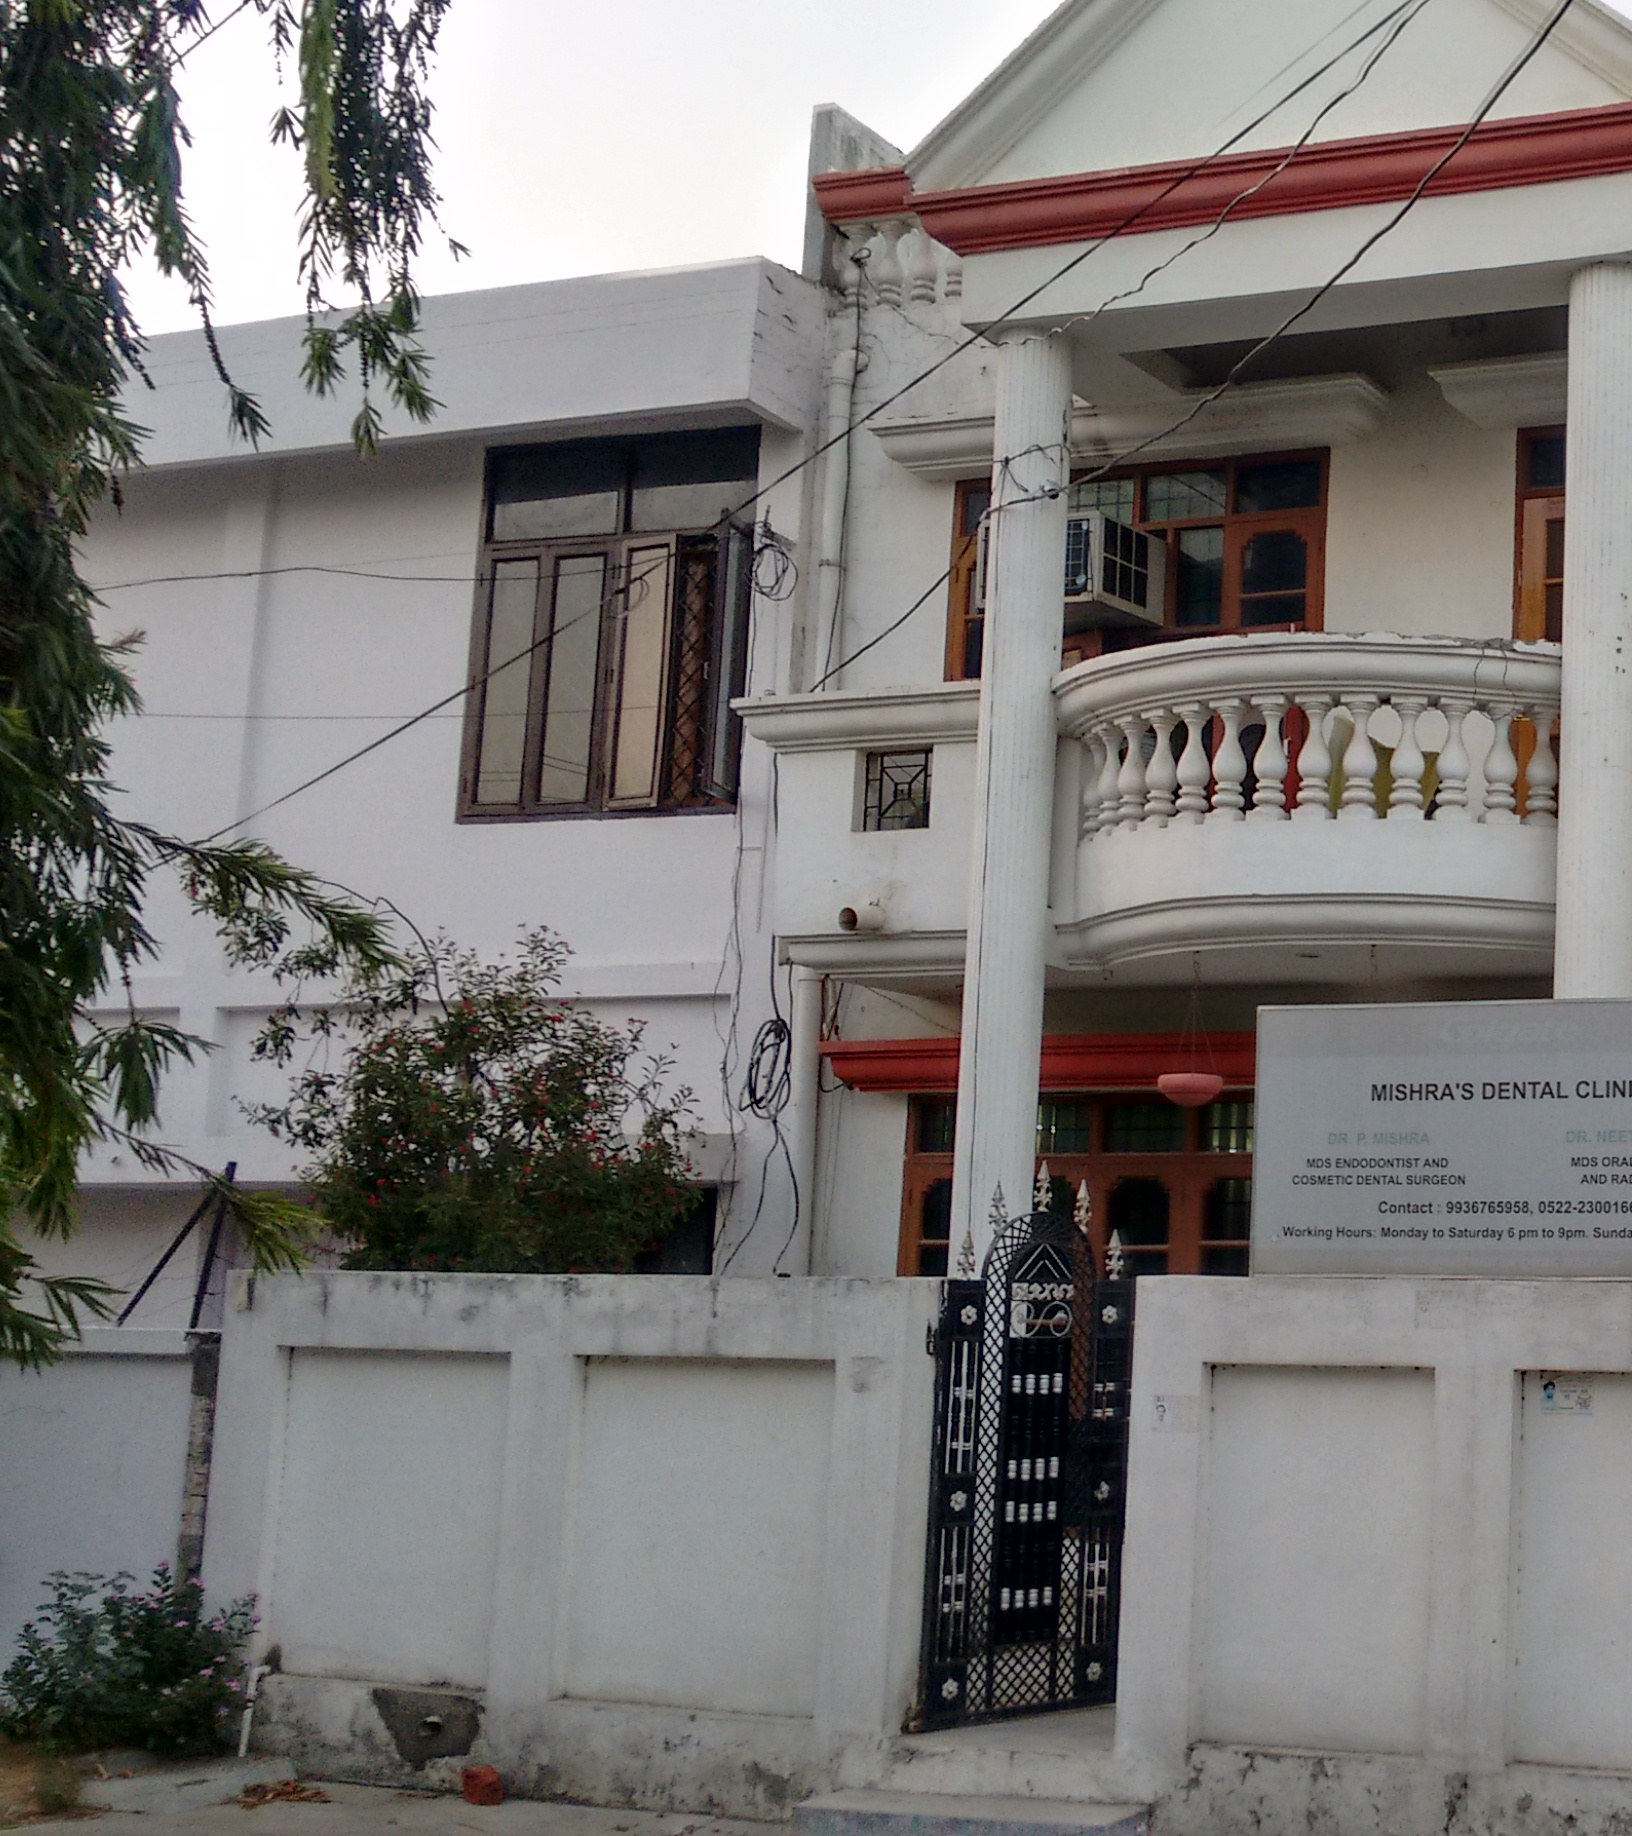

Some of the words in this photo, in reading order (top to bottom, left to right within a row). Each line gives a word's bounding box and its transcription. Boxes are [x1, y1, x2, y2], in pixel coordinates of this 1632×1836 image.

[1371, 1082, 1474, 1101] MISHRA'S
[1482, 1081, 1568, 1099] DENTAL
[1373, 1132, 1430, 1145] MISHRA
[1306, 1158, 1332, 1169] MDS
[1335, 1157, 1420, 1168] ENDODONTIST
[1423, 1157, 1449, 1168] AND
[1570, 1156, 1598, 1167] MDS
[1292, 1175, 1353, 1186] COSMETIC
[1356, 1175, 1402, 1185] DENTAL
[1406, 1175, 1466, 1185] SURGEON
[1580, 1174, 1607, 1184] AND
[1378, 1201, 1433, 1214] Contact
[1446, 1201, 1533, 1215] 9936765958,
[1282, 1226, 1332, 1240] Working
[1336, 1226, 1377, 1238] Hours:
[1380, 1227, 1429, 1240] Monday
[1433, 1228, 1444, 1238] to
[1449, 1227, 1503, 1240] Saturday
[1507, 1228, 1515, 1238] 6
[1518, 1230, 1538, 1240] pm
[1542, 1228, 1554, 1238] to
